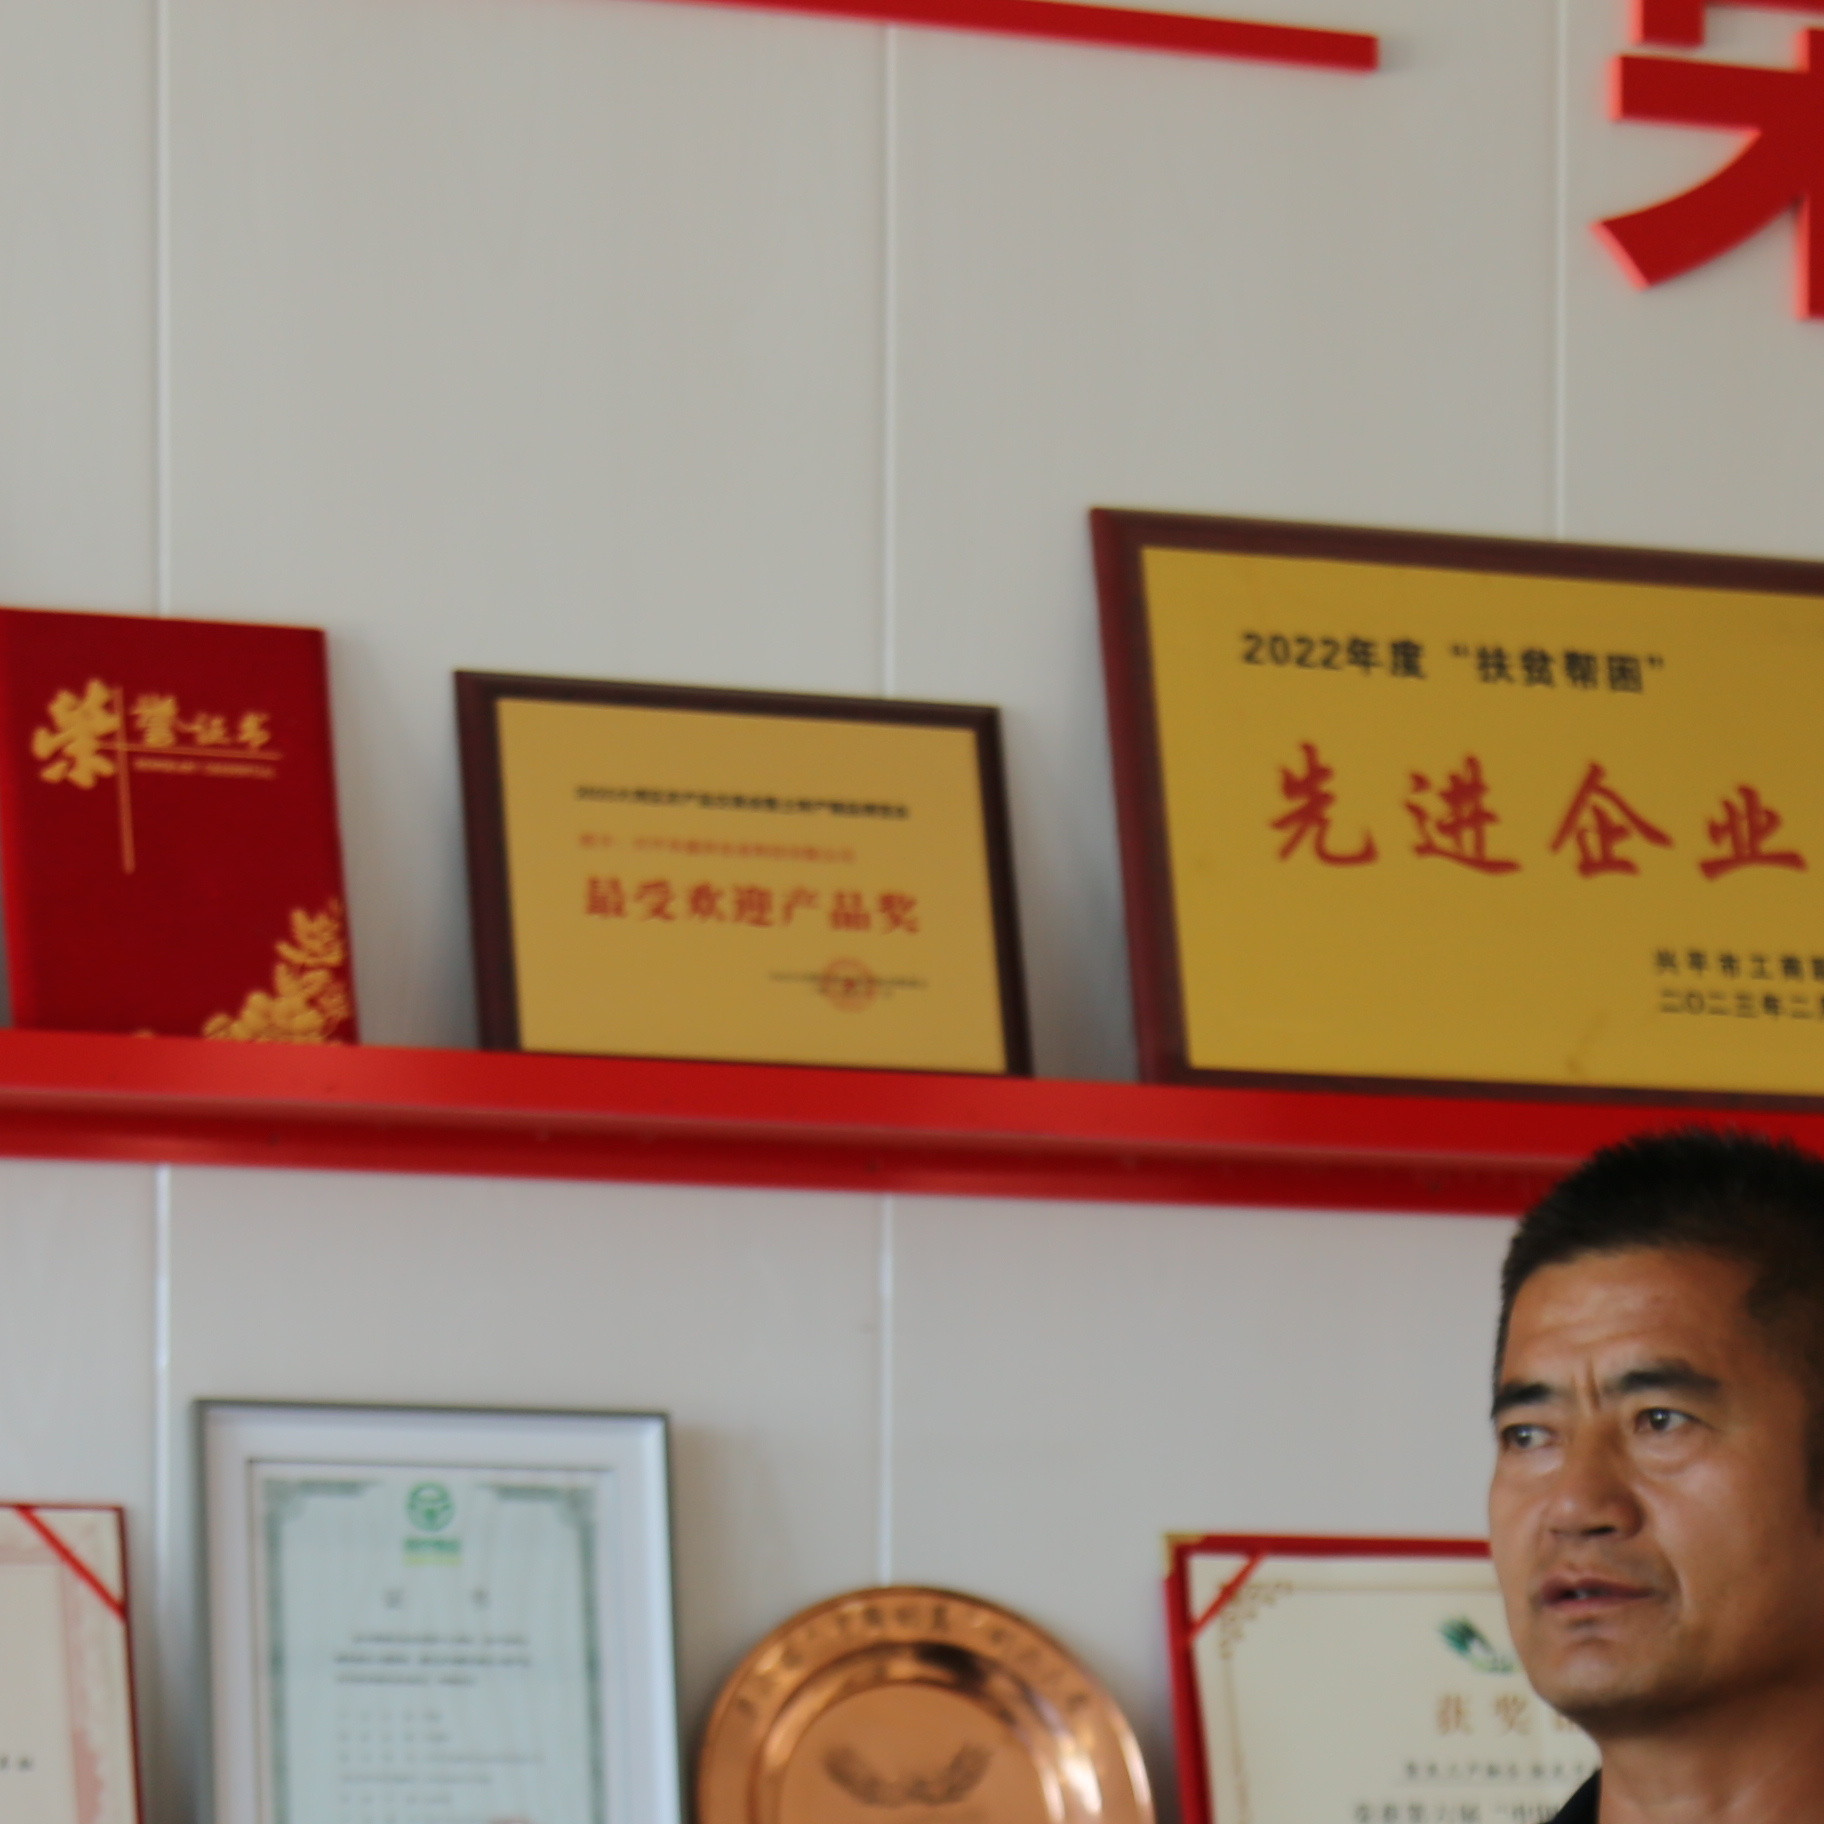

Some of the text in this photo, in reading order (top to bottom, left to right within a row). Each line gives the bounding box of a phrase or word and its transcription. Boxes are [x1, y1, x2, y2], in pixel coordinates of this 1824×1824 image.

[1240, 629, 1668, 694] 2022年度“扶贫帮困”
[31, 678, 273, 789] 荣誉证书
[1269, 740, 1810, 882] 先进企业
[582, 872, 922, 936] 最受欢迎产品奖
